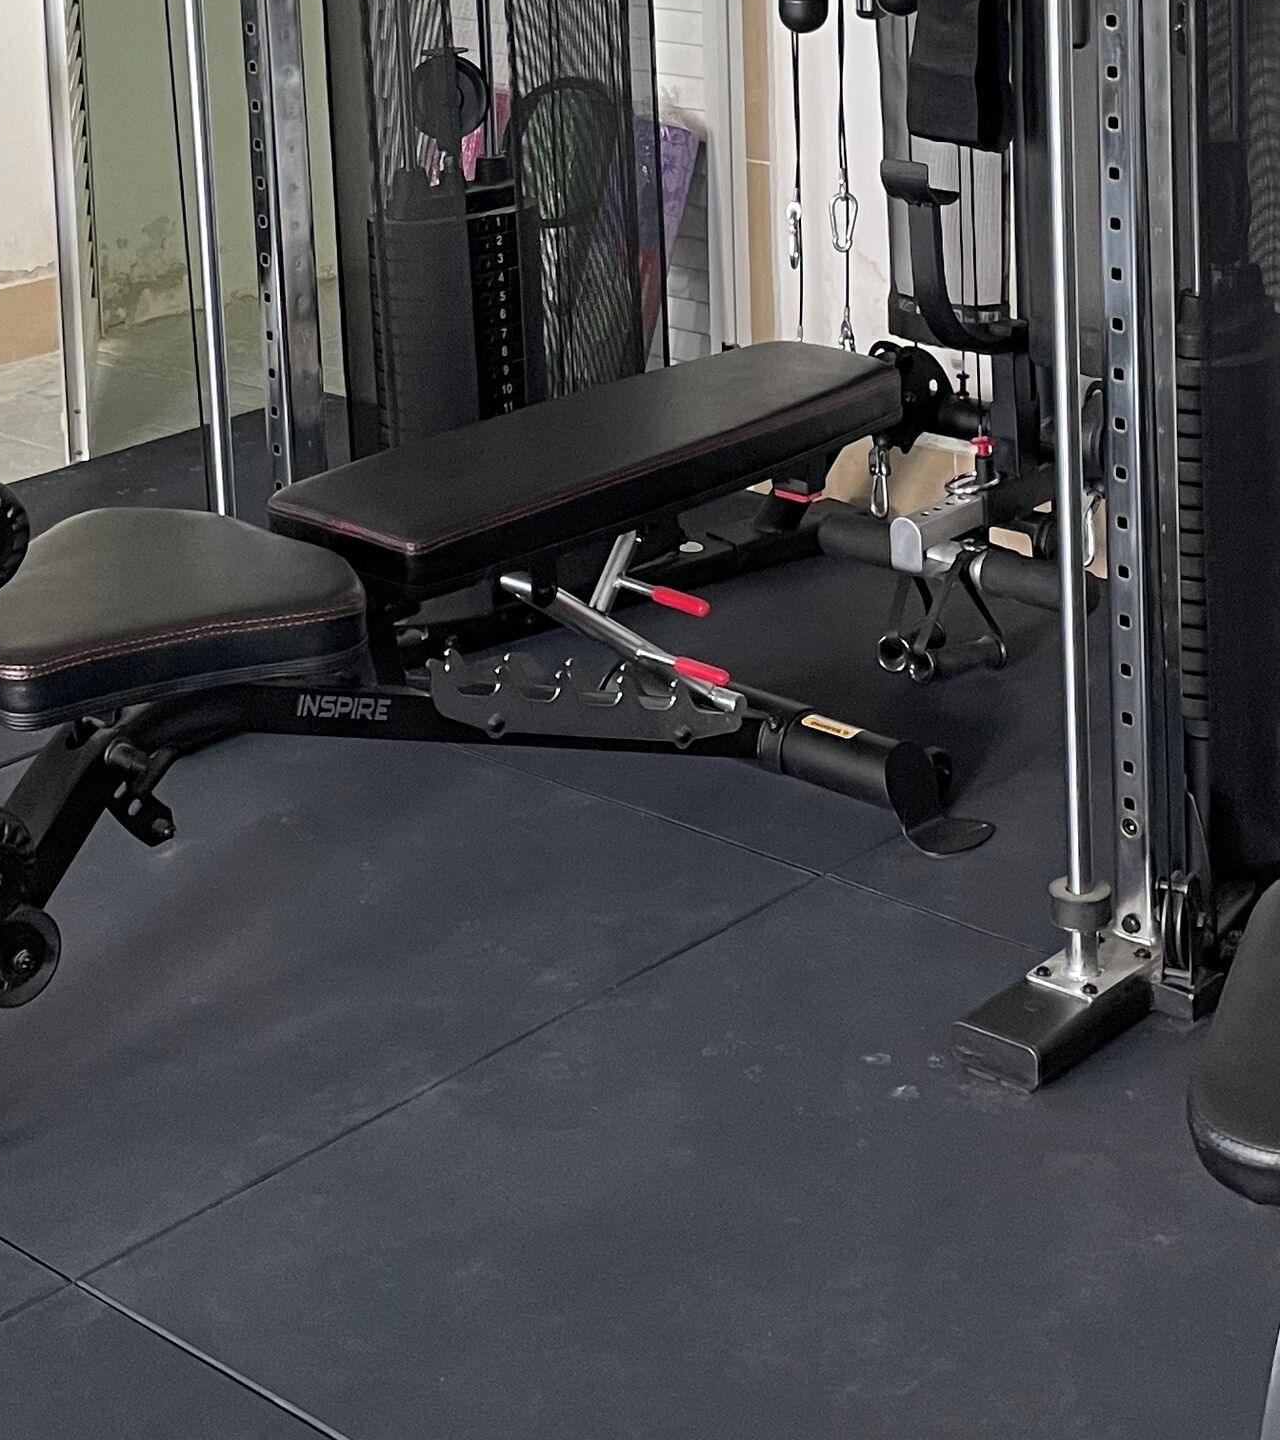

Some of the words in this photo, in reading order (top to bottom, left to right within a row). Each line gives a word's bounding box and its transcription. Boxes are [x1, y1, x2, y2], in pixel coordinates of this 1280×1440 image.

[496, 235, 503, 246] 2
[497, 253, 504, 264] 3
[498, 271, 505, 282] 4
[500, 291, 506, 302] 5
[500, 308, 507, 319] 6
[500, 327, 508, 339] 7
[501, 345, 508, 357] 8
[503, 364, 509, 376] 9
[502, 383, 513, 394] 10
[296, 694, 392, 721] INSPIRE
